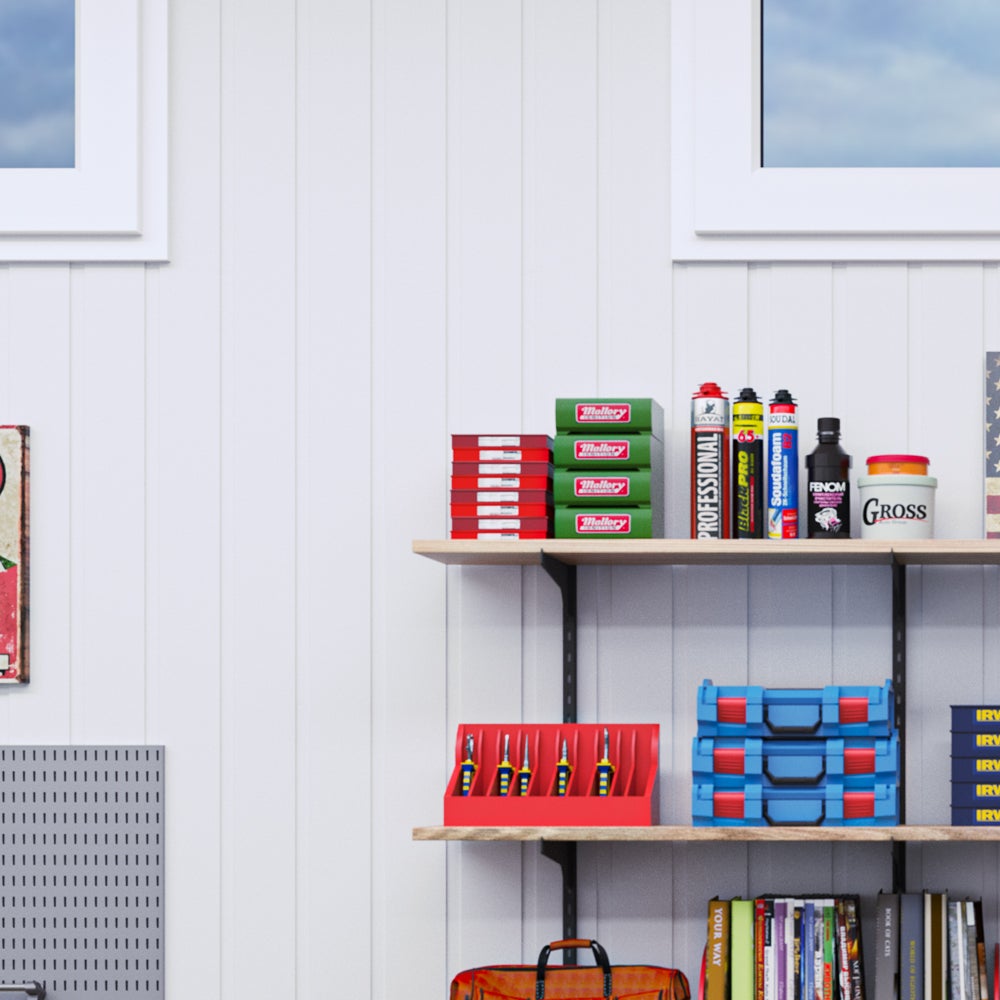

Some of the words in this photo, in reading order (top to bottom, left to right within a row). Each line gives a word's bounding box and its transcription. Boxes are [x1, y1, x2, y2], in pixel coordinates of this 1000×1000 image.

[581, 407, 627, 416] Mallory
[580, 443, 626, 453] Mallory
[771, 433, 783, 507] Soudafoam
[580, 480, 626, 490] Mallory
[810, 482, 846, 492] FENOM
[863, 498, 927, 526] GROSS
[581, 516, 627, 527] Mallory
[714, 908, 723, 939] YOUR
[886, 929, 892, 938] OF
[713, 942, 722, 967] WAY
